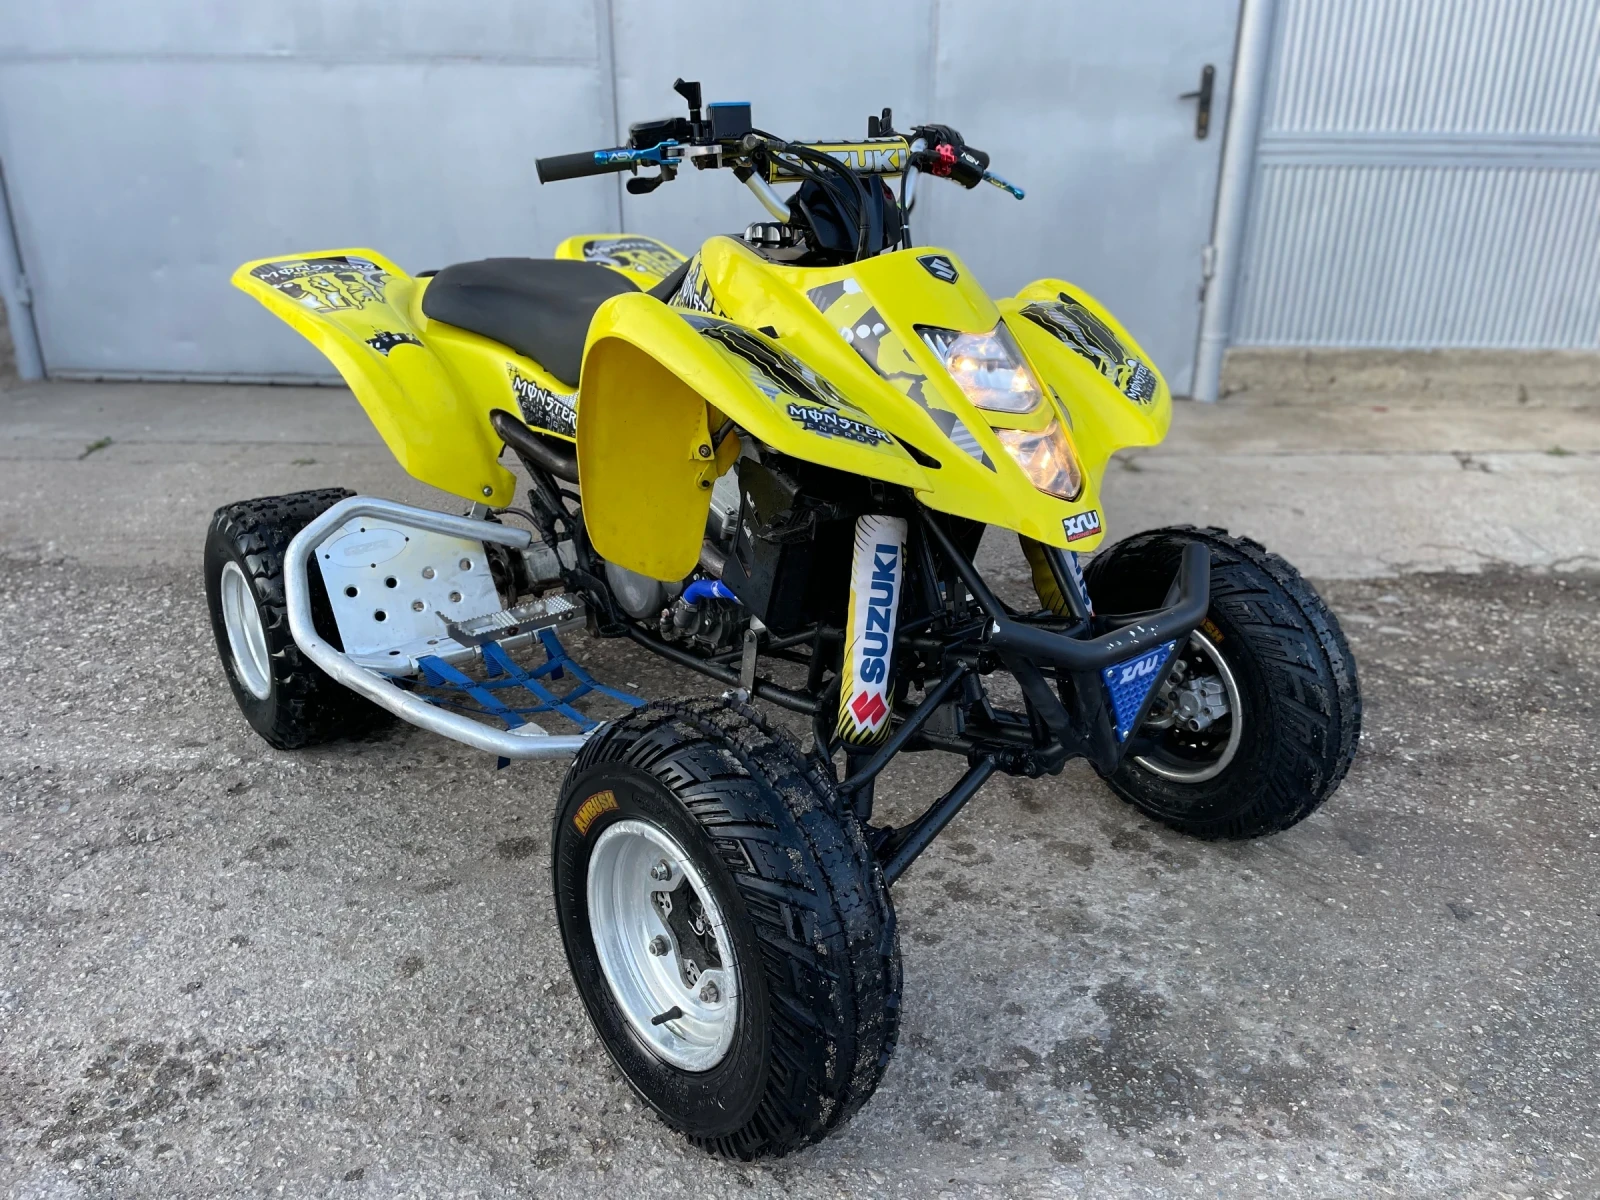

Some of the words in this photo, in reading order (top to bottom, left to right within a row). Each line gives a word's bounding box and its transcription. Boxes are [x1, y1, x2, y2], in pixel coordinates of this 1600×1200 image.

[609, 151, 635, 161] ASV
[778, 148, 907, 176] SZUKI
[514, 376, 577, 429] MONSTER
[789, 405, 891, 443] MONSTER
[806, 422, 876, 445] ENERGY
[860, 543, 899, 685] SUZUKI
[574, 791, 618, 834] AMBUSH
